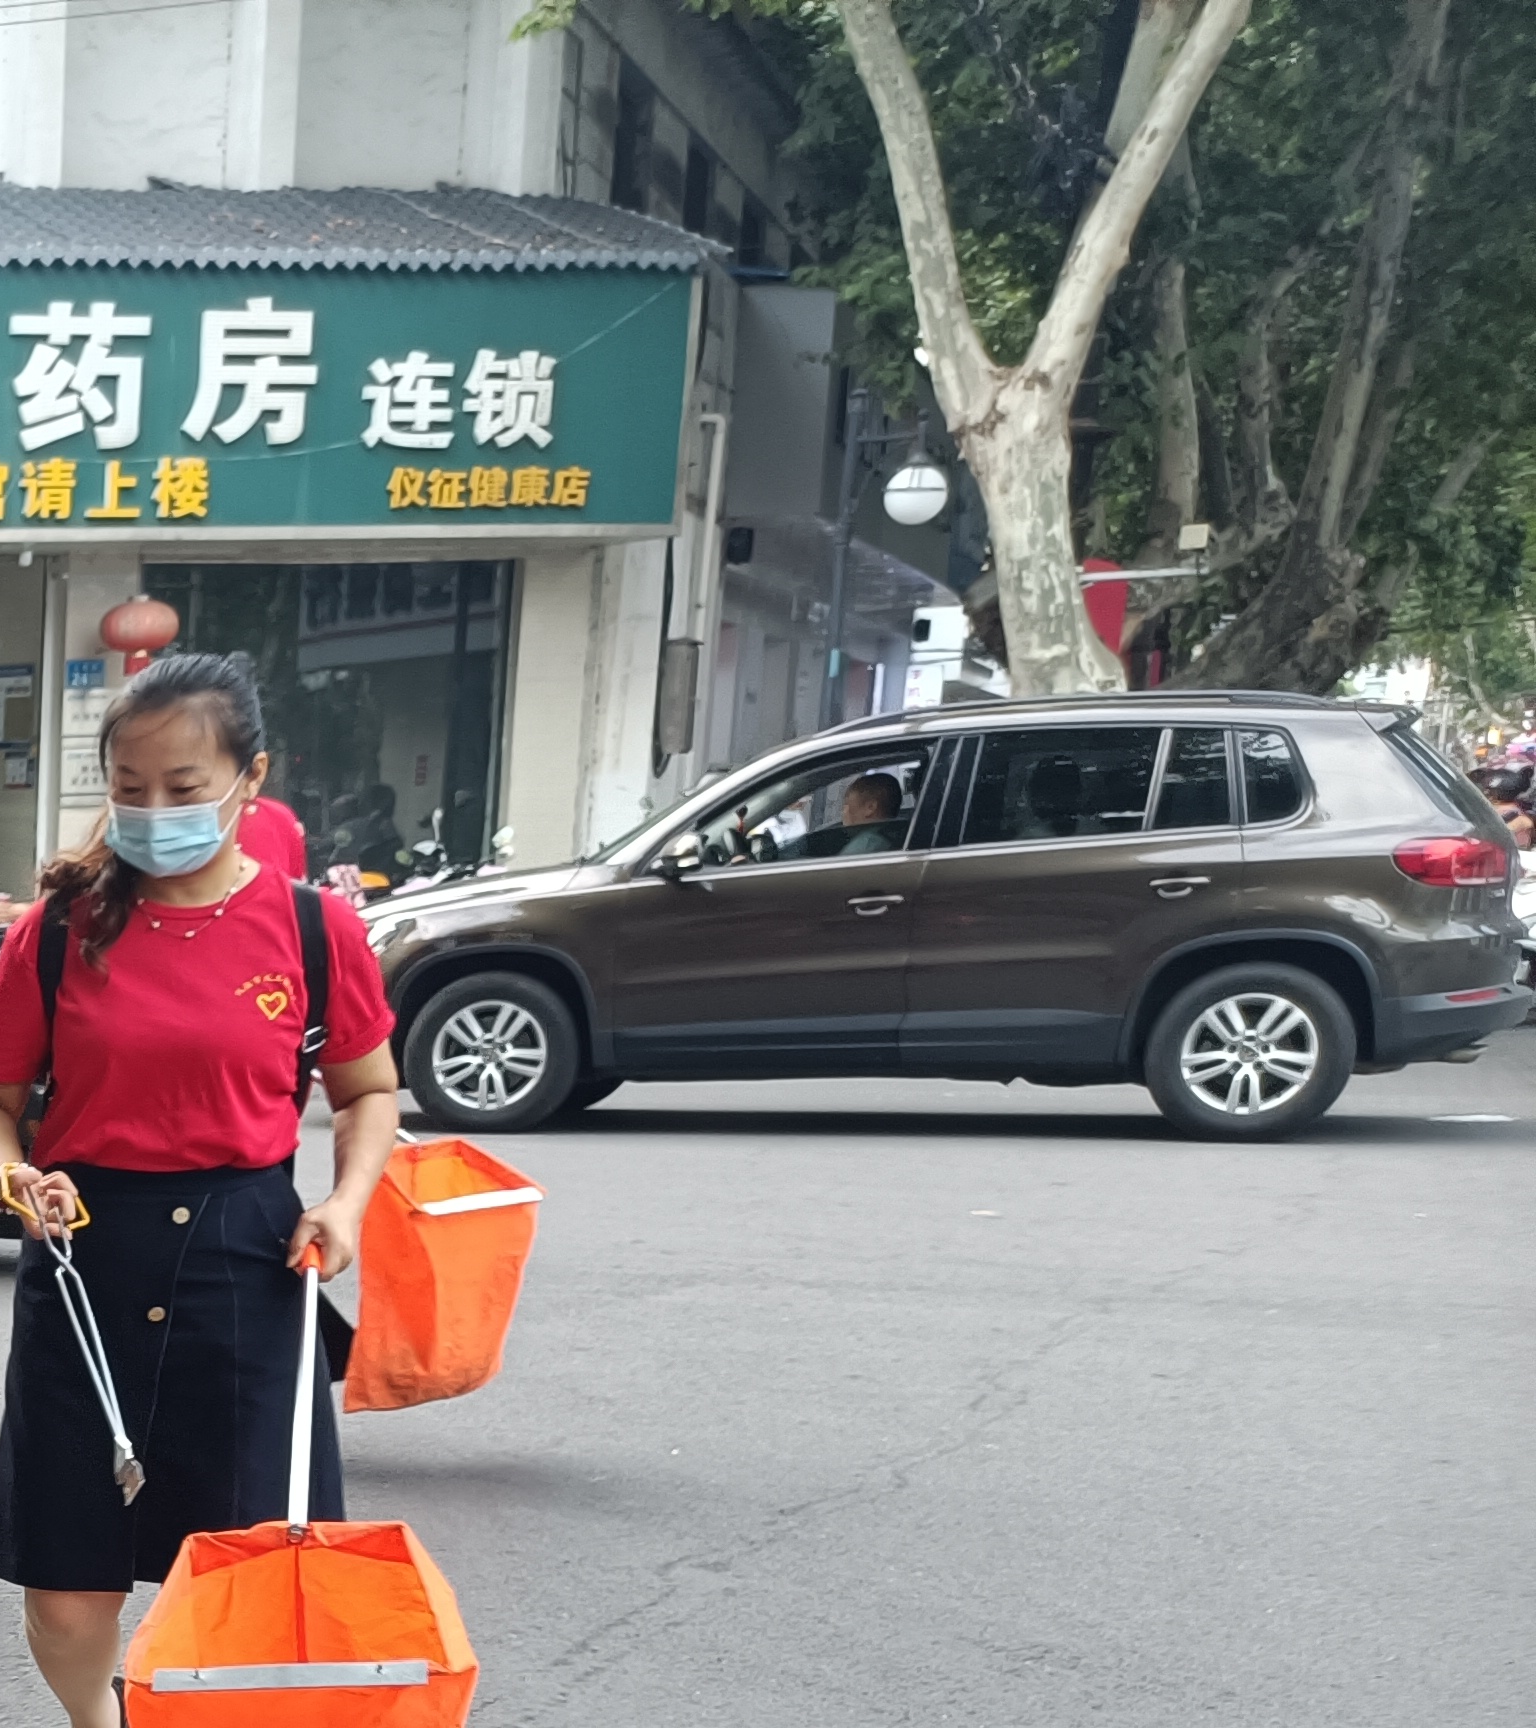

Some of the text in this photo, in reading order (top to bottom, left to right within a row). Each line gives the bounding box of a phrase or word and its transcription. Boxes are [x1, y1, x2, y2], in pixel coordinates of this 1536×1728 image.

[361, 349, 557, 448] 连锁
[386, 465, 591, 509] 仪征健康店
